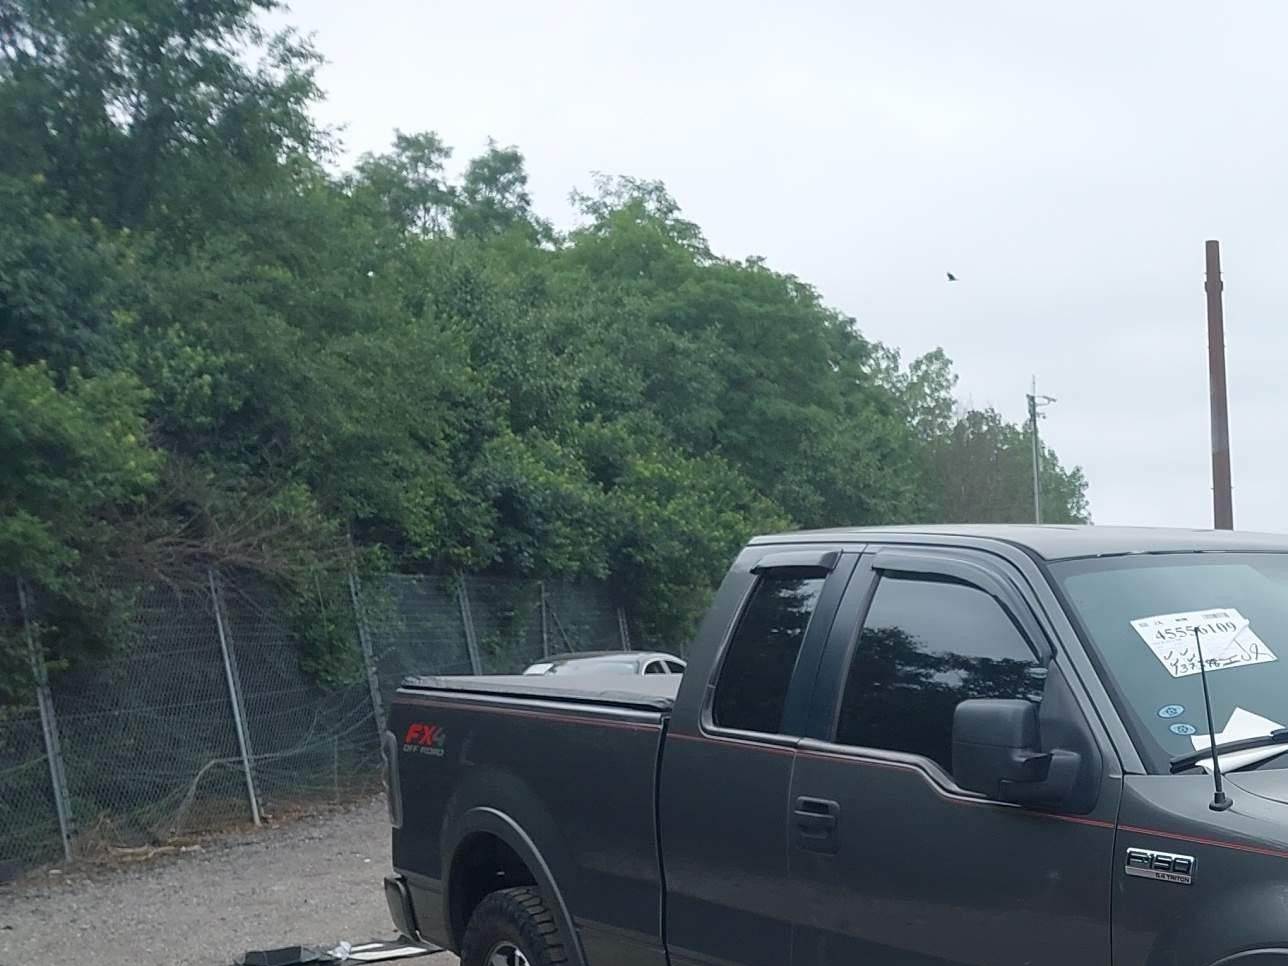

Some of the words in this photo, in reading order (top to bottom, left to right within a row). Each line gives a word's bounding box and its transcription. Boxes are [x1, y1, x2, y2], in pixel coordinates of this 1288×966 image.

[1155, 621, 1237, 641] 45556109
[405, 722, 446, 747] FX4
[1167, 874, 1190, 883] TRITON
